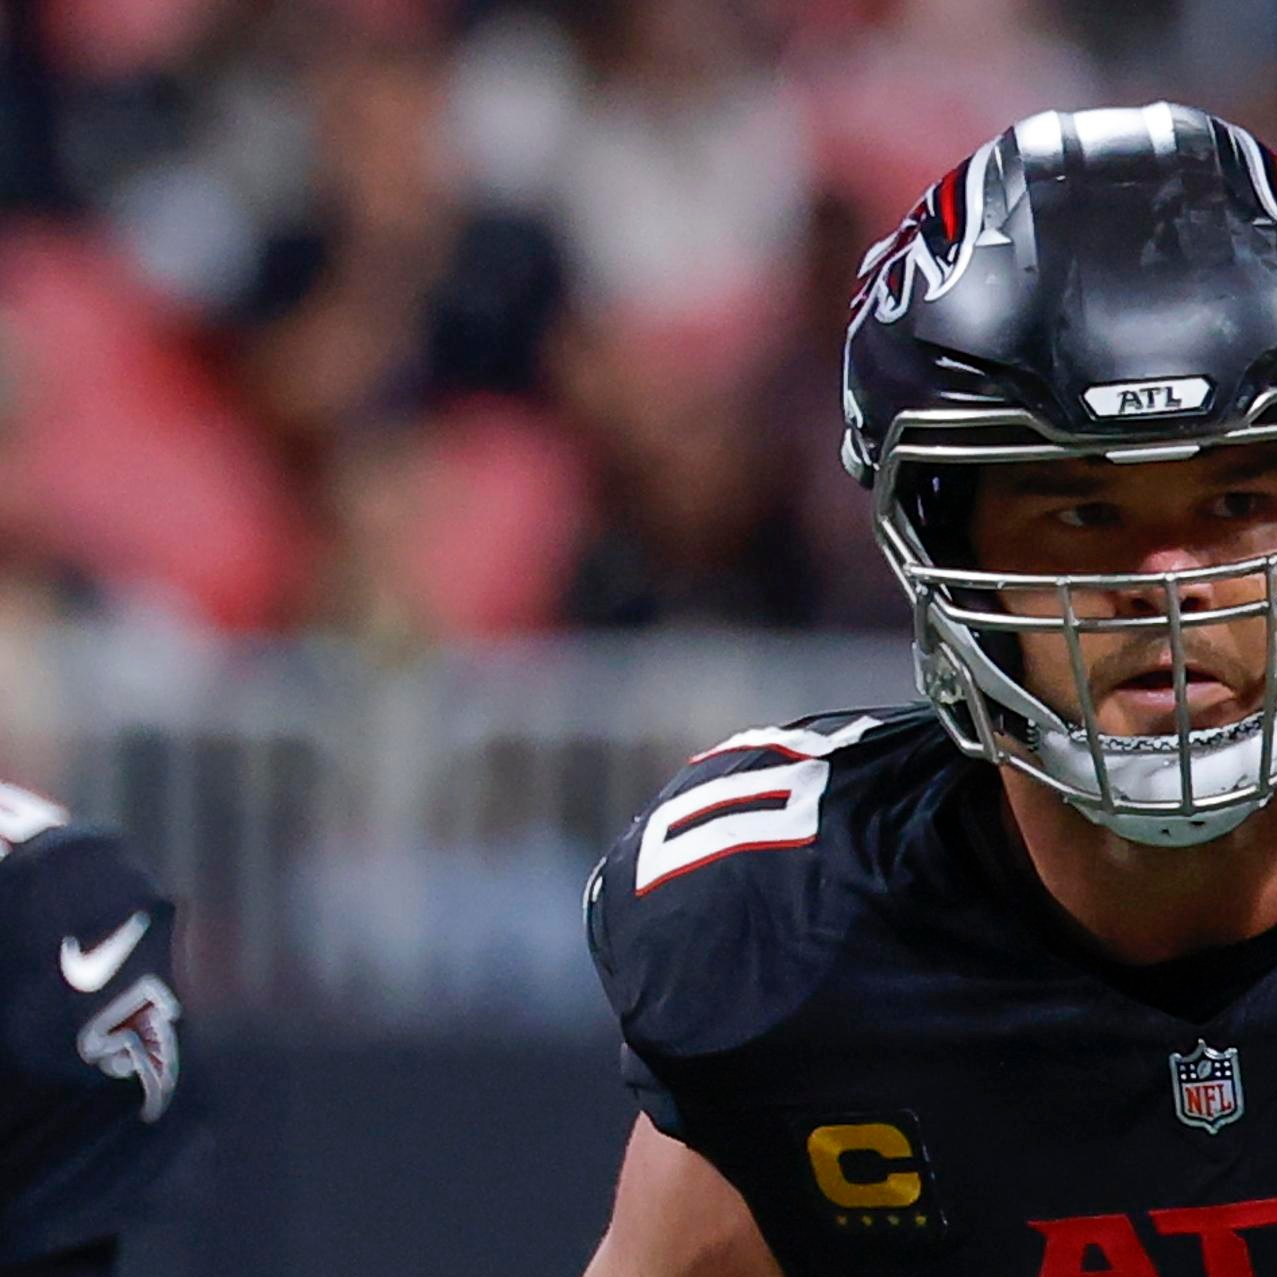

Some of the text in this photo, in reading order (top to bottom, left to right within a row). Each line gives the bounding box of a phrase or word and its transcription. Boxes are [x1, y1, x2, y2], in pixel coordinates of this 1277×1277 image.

[1118, 386, 1182, 414] ATL
[1185, 1084, 1232, 1117] NFL
[807, 1123, 922, 1208] C
